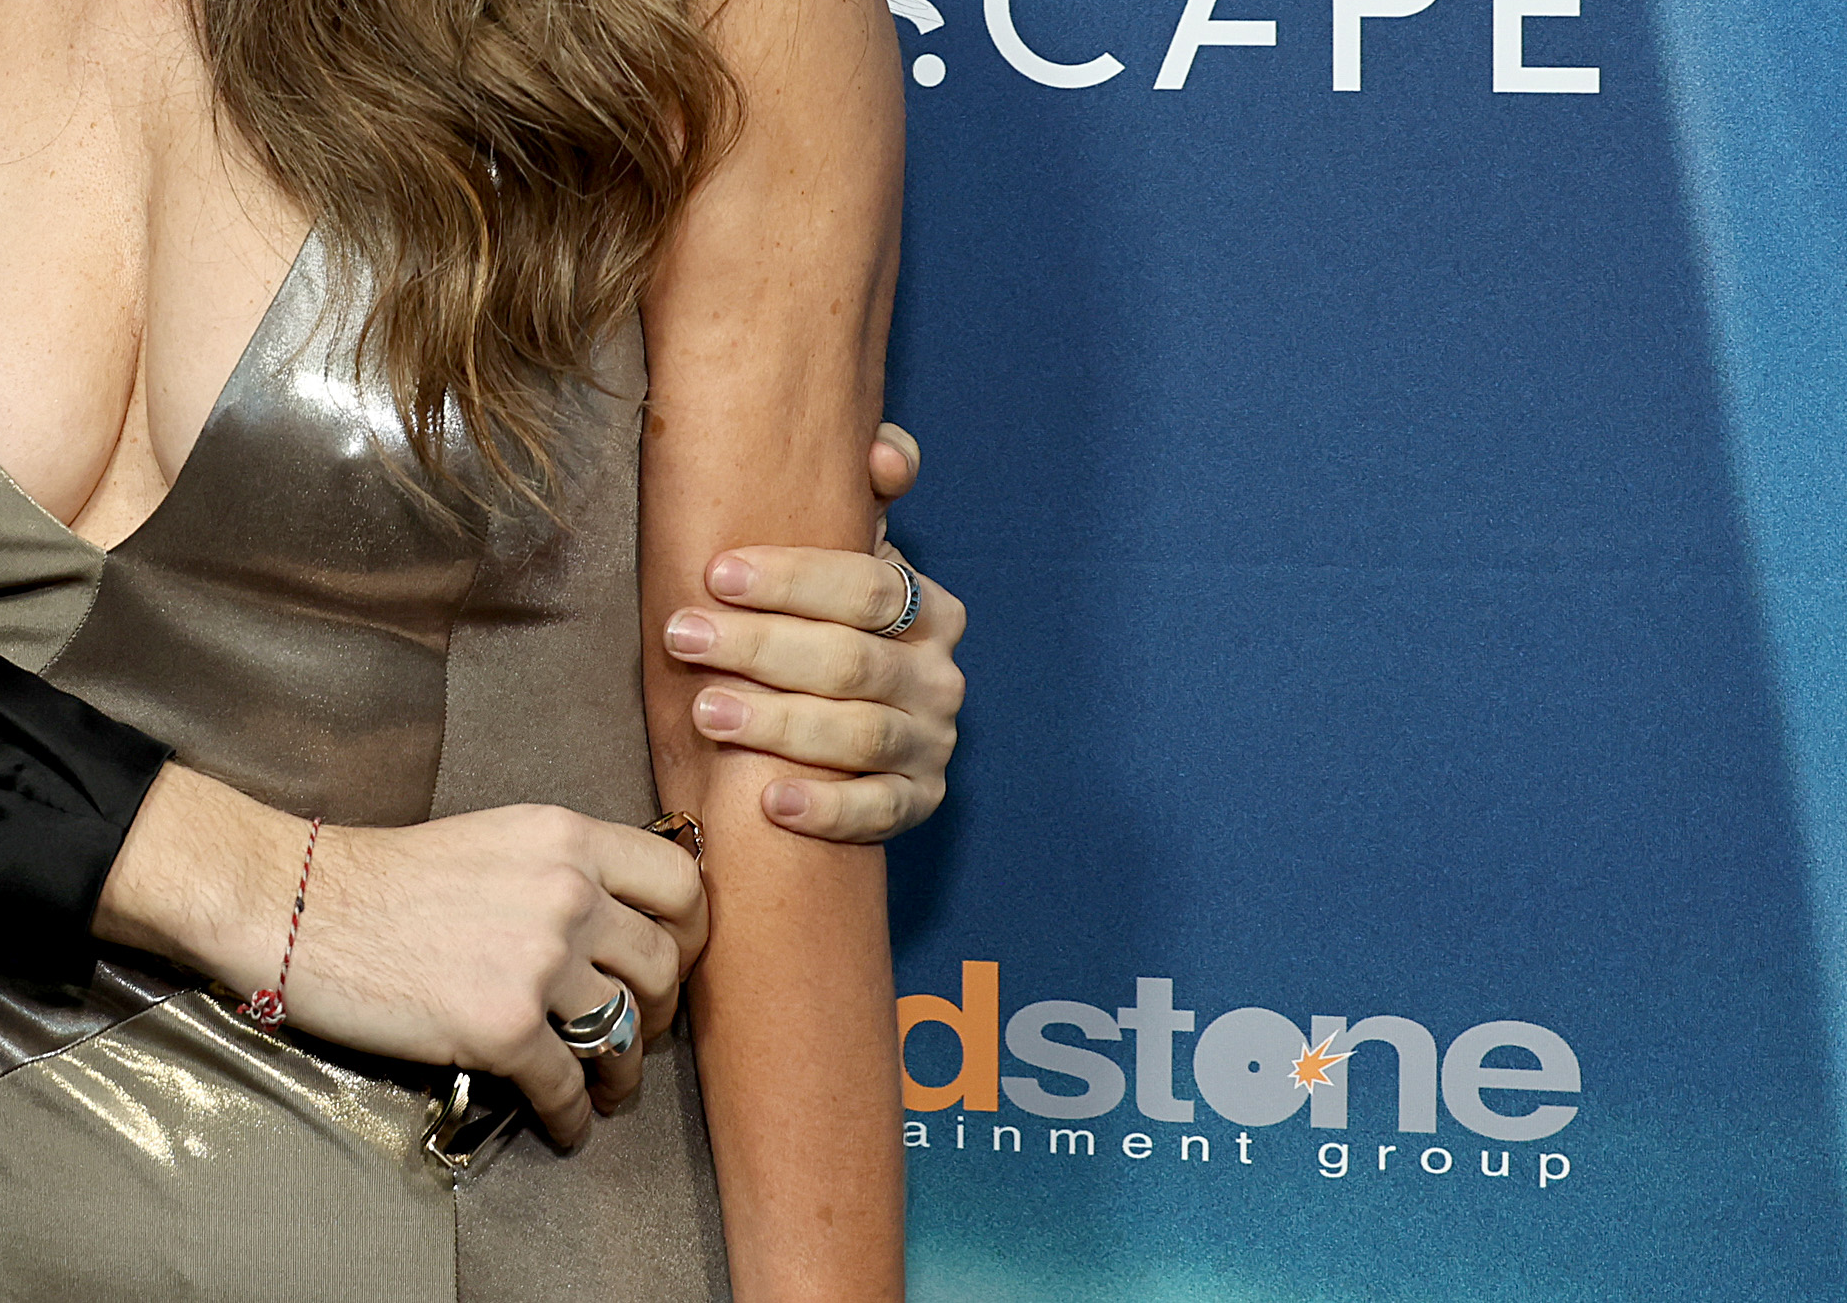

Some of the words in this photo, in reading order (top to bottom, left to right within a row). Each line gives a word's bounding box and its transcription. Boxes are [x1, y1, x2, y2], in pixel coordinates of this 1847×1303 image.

[897, 961, 1581, 1141] dstone
[903, 1115, 1253, 1164] ainment
[1318, 1143, 1571, 1188] group
